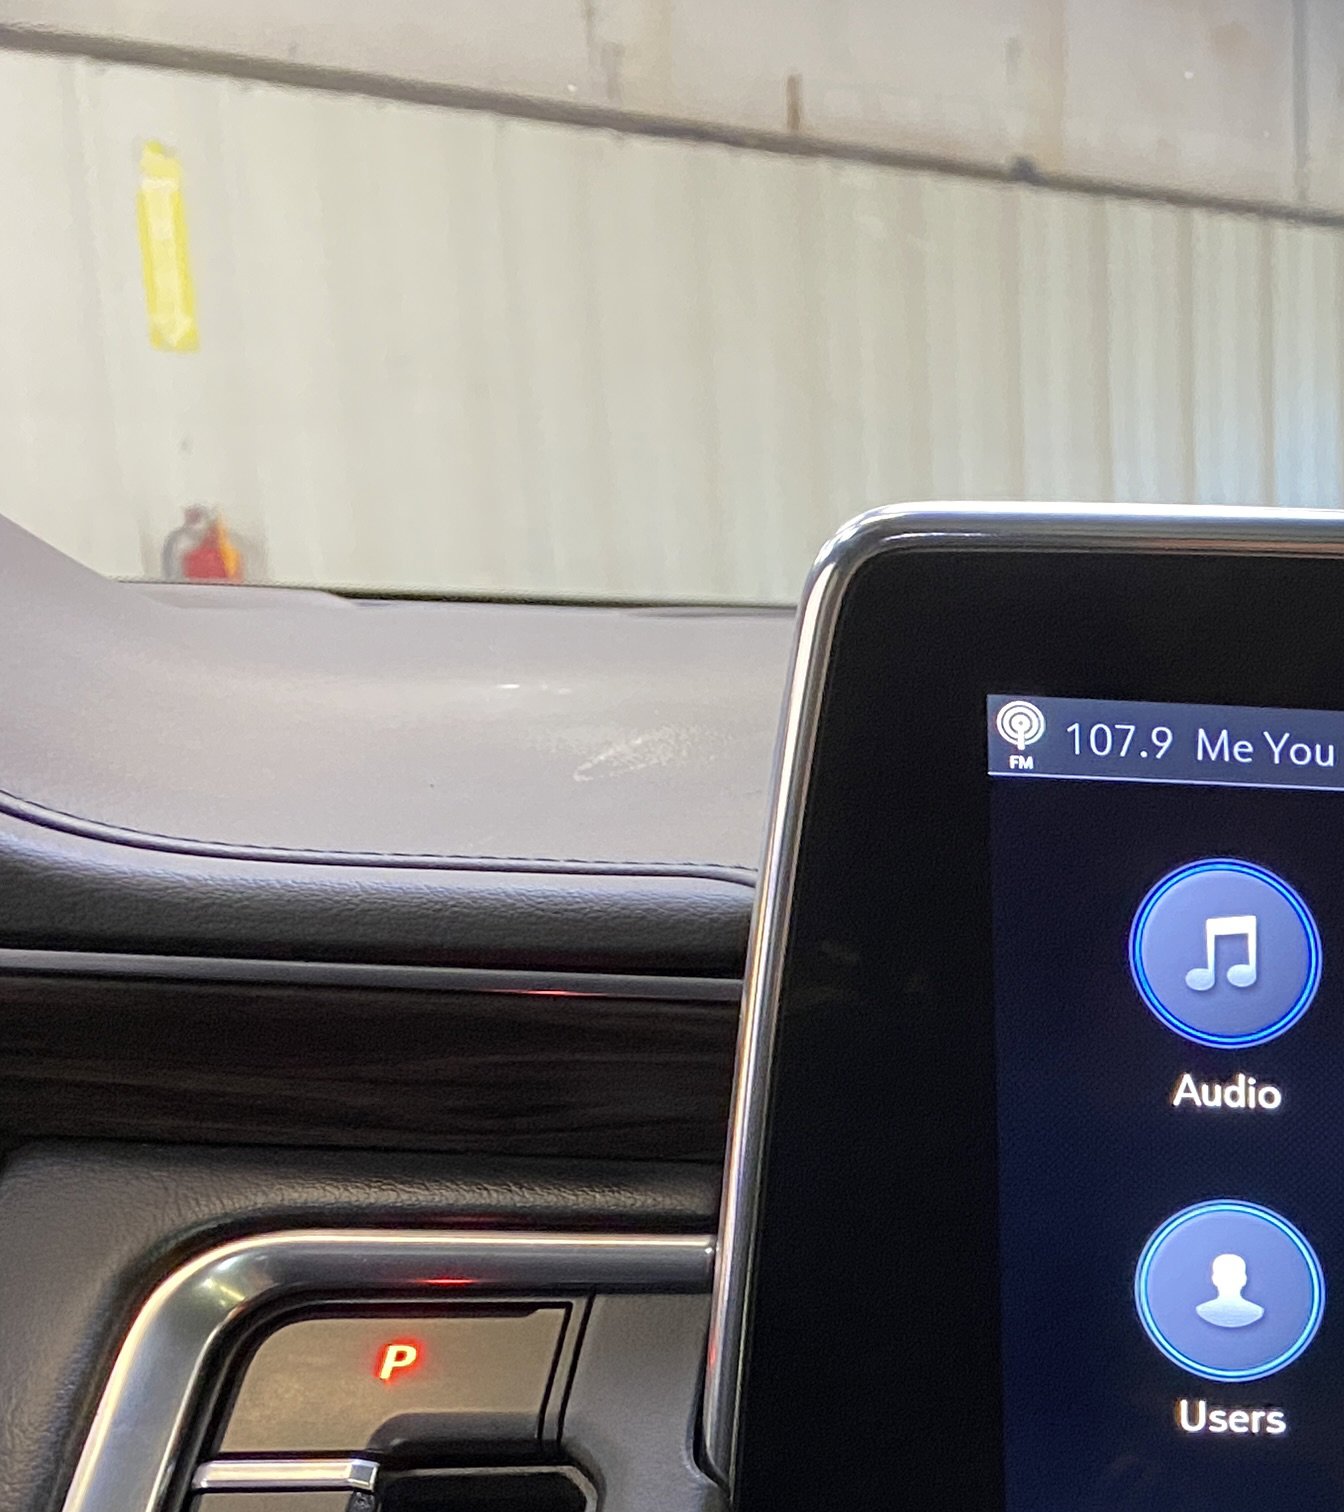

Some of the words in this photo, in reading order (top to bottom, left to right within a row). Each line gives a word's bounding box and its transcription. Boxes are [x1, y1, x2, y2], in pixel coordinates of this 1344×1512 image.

[1008, 753, 1035, 771] FM
[1064, 721, 1174, 760] 107.9
[1195, 726, 1255, 764] Me
[1262, 730, 1336, 768] You
[1171, 1071, 1283, 1111] Audio
[379, 1343, 417, 1381] P
[1177, 1398, 1288, 1436] Users
